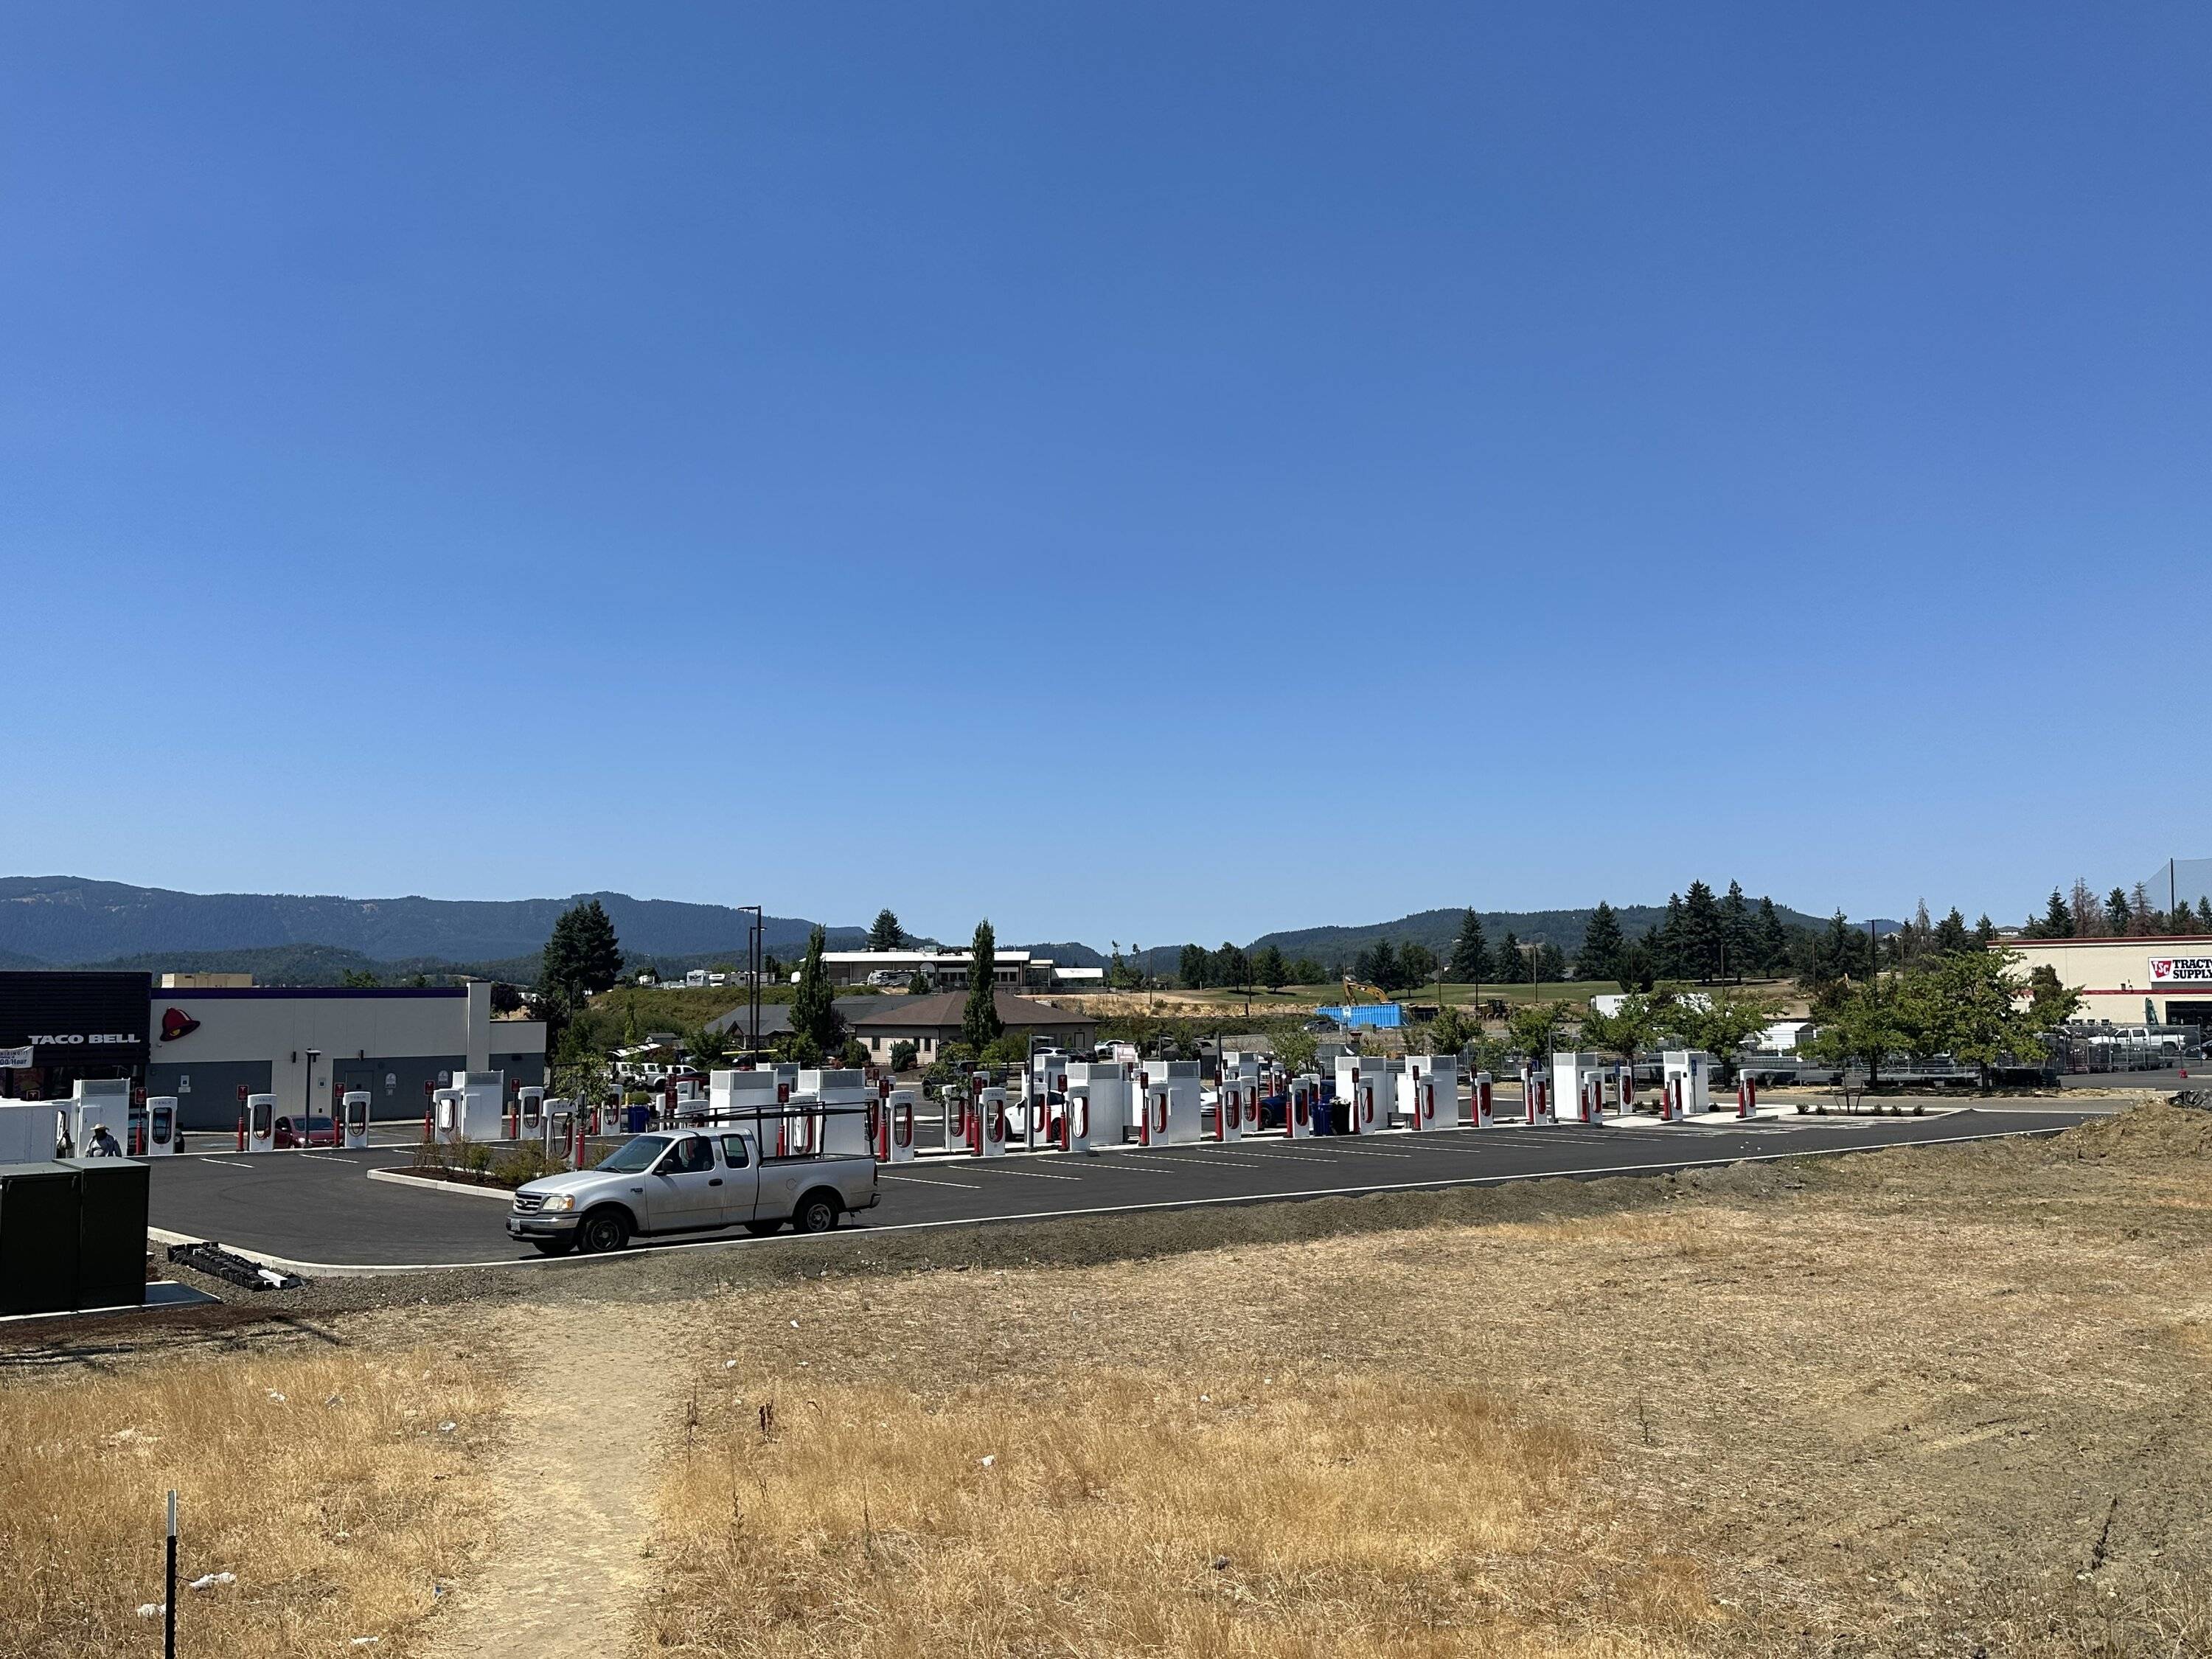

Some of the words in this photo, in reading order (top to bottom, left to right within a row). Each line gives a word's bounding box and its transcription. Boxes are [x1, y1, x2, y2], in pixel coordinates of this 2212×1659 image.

[2153, 961, 2169, 975] TSC
[2172, 959, 2212, 969] TRACT
[28, 1034, 84, 1044] TACO
[88, 1034, 141, 1043] BELL
